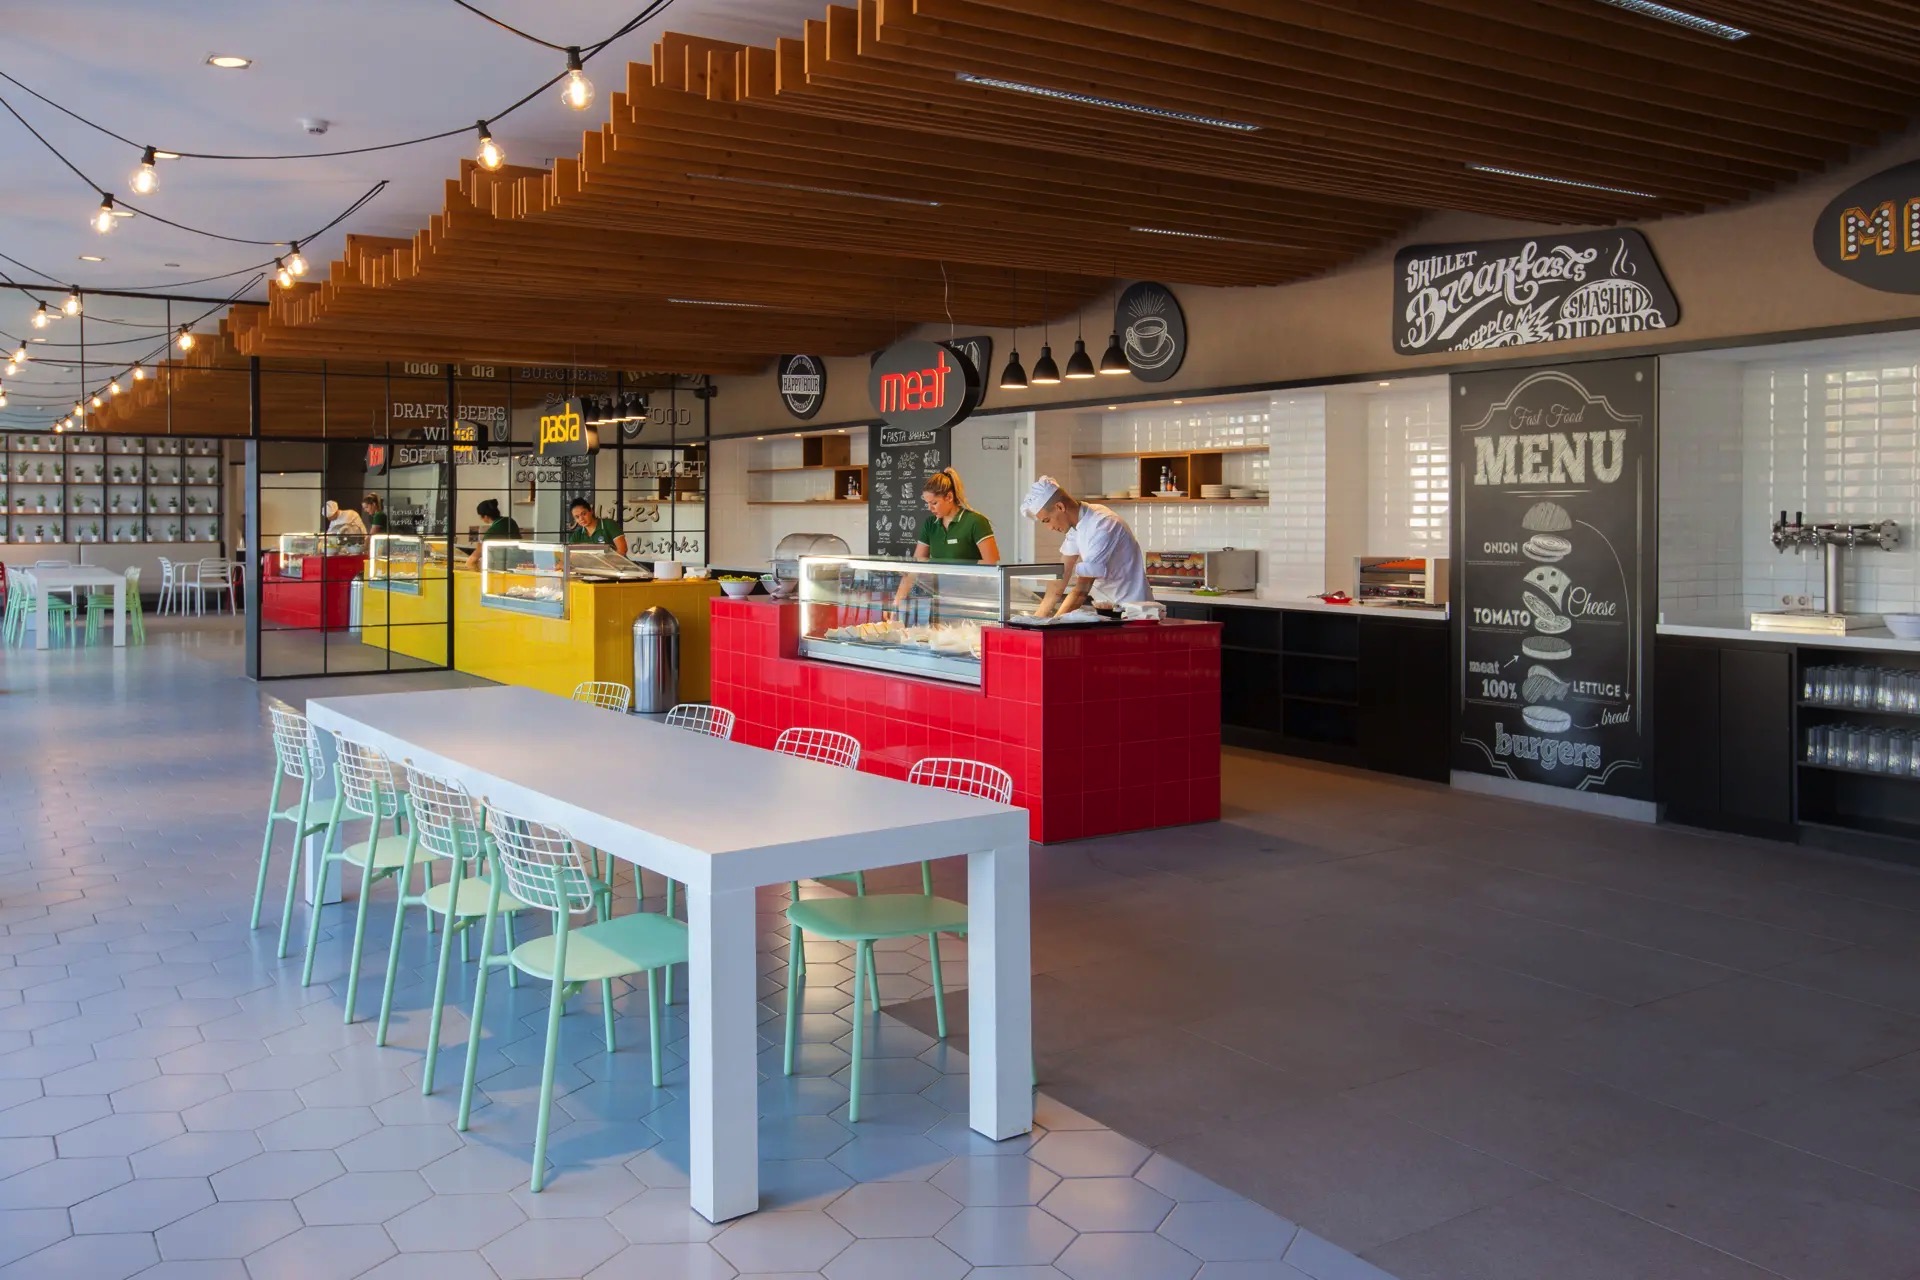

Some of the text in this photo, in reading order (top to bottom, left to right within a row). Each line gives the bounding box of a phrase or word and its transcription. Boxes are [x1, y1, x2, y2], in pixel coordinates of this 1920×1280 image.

[1405, 251, 1478, 293] SKILLET
[1569, 287, 1644, 318] SMASHED
[783, 377, 819, 392] HAPPY HOUR
[880, 350, 951, 413] meat
[458, 405, 506, 421] BEERS
[1510, 403, 1586, 430] Fast Food
[540, 402, 580, 455] pasta
[886, 430, 906, 443] PASTA
[400, 447, 438, 464] SOFT
[1474, 429, 1627, 486] MENU
[516, 470, 584, 483] COOKIES
[623, 461, 705, 478] MARKET
[631, 536, 700, 555] drinks
[1483, 541, 1518, 554] ONION
[1567, 585, 1616, 618] Cheese
[1473, 607, 1531, 627] TOMATO
[1469, 660, 1500, 675] meat
[1481, 678, 1518, 699] 100%
[1573, 680, 1621, 697] LETTUCE
[1601, 704, 1631, 726] bread
[1494, 722, 1601, 770] burgers
